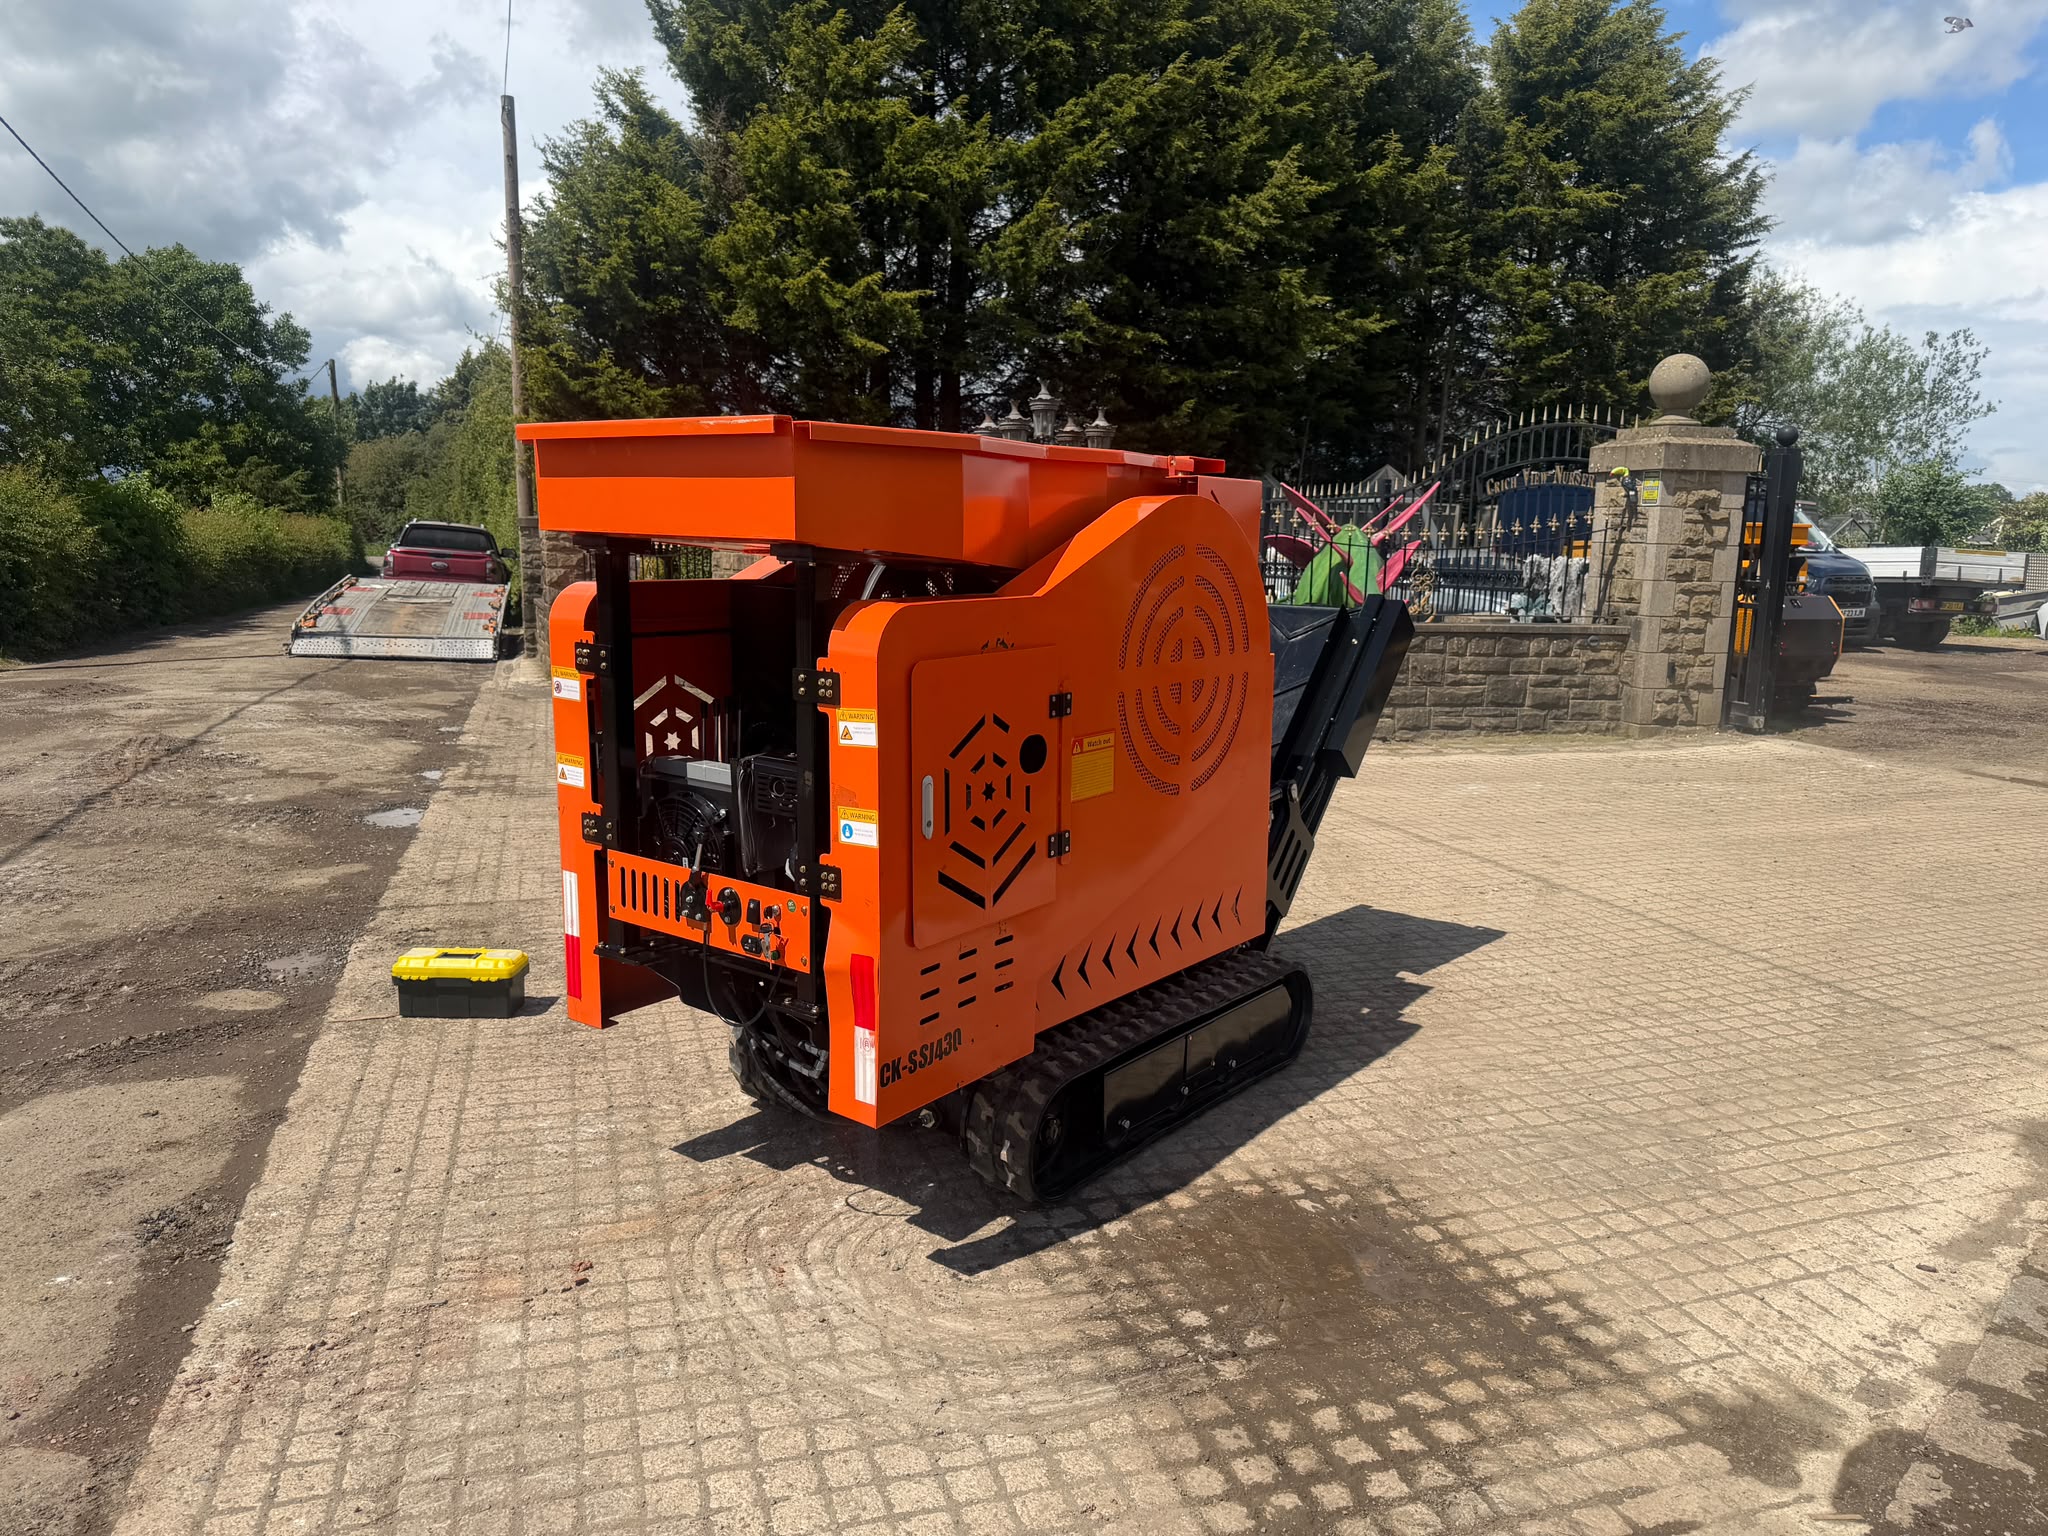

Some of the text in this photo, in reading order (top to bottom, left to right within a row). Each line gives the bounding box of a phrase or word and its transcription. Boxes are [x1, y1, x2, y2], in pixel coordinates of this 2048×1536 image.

[1553, 465, 1595, 488] NURSER
[560, 670, 578, 679] WARNING
[848, 712, 874, 720] WARNING
[1087, 739, 1102, 748] Watch
[564, 757, 583, 766] WARNING
[850, 812, 875, 822] WARNING
